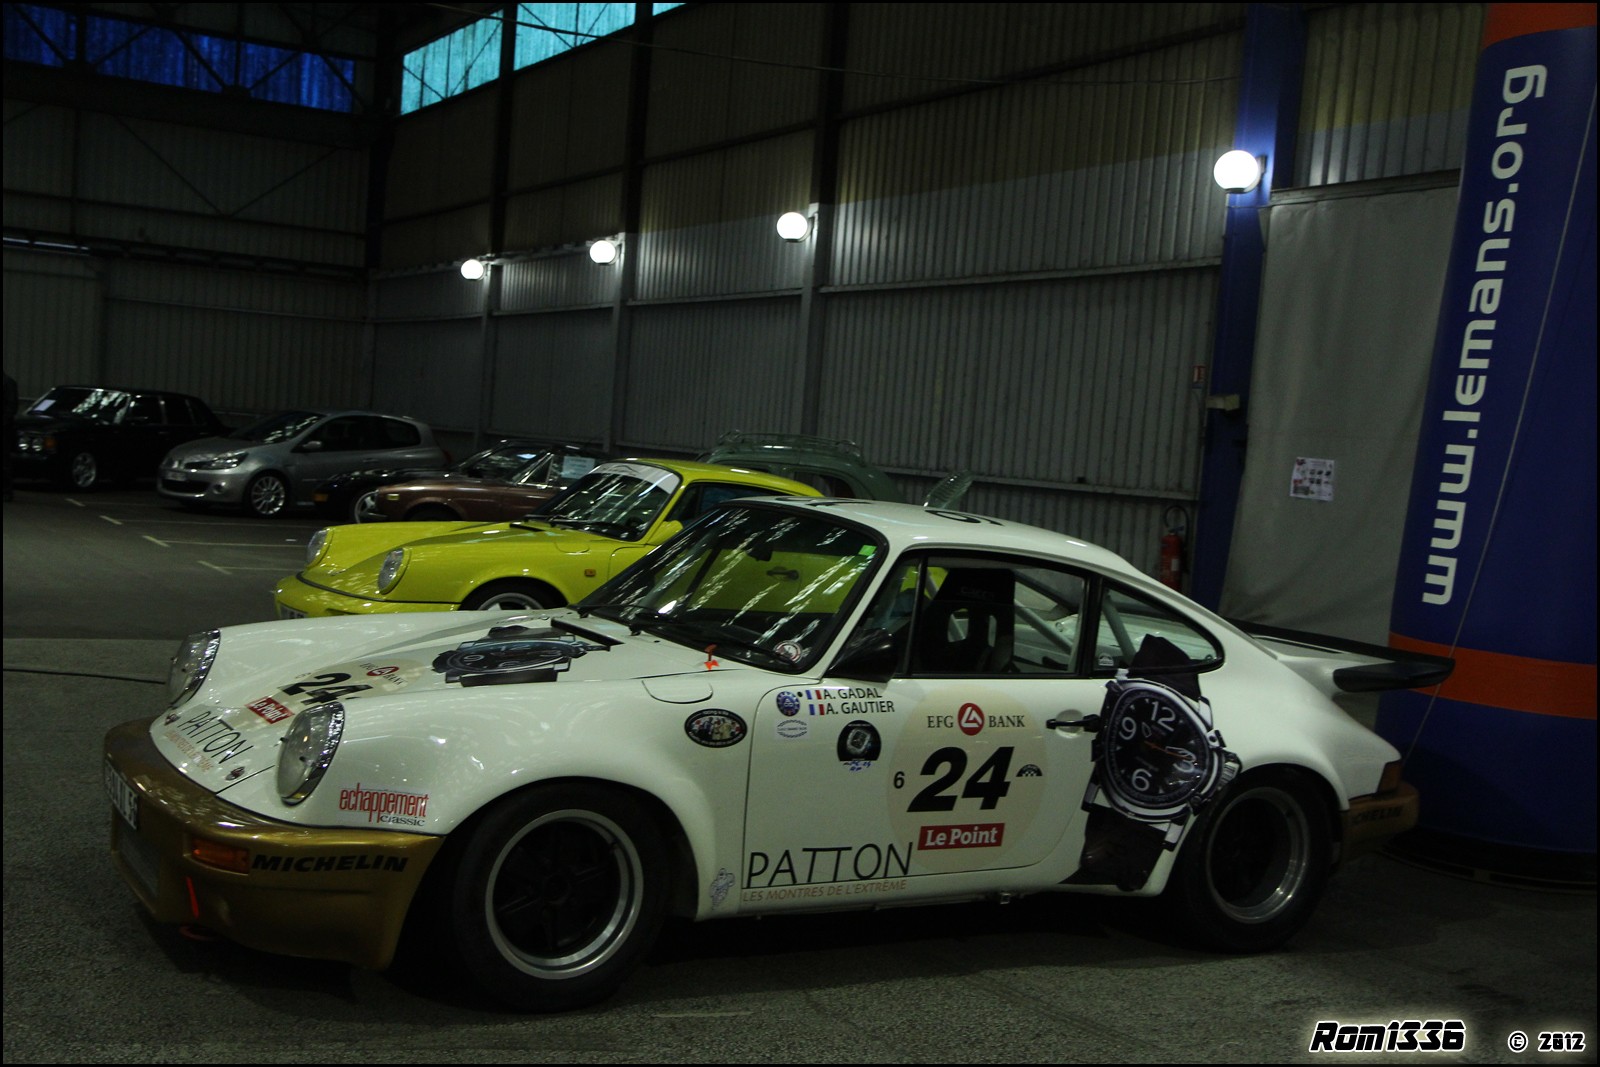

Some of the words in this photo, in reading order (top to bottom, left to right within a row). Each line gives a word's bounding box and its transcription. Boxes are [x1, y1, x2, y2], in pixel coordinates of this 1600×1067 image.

[1421, 64, 1548, 605] www.lemans.org
[283, 673, 373, 705] 24
[824, 689, 836, 700] A.
[838, 688, 882, 700] GADAL
[827, 703, 838, 715] A.
[841, 701, 895, 714] GAUTIER
[1150, 700, 1177, 732] 12
[927, 715, 954, 728] EFG
[988, 715, 1025, 728] BANK
[1118, 716, 1138, 740] 9
[177, 711, 254, 764] PATTON
[893, 771, 905, 789] 6
[907, 747, 1015, 812] 24
[1131, 768, 1152, 792] 6
[339, 783, 430, 823] echappement
[380, 815, 426, 827] classic
[925, 829, 947, 847] Le
[949, 826, 998, 846] Point
[251, 854, 409, 873] MICHELIN
[746, 842, 913, 889] PATTON
[743, 889, 763, 902] LES
[767, 886, 824, 901] MONTRES
[827, 884, 842, 896] DE
